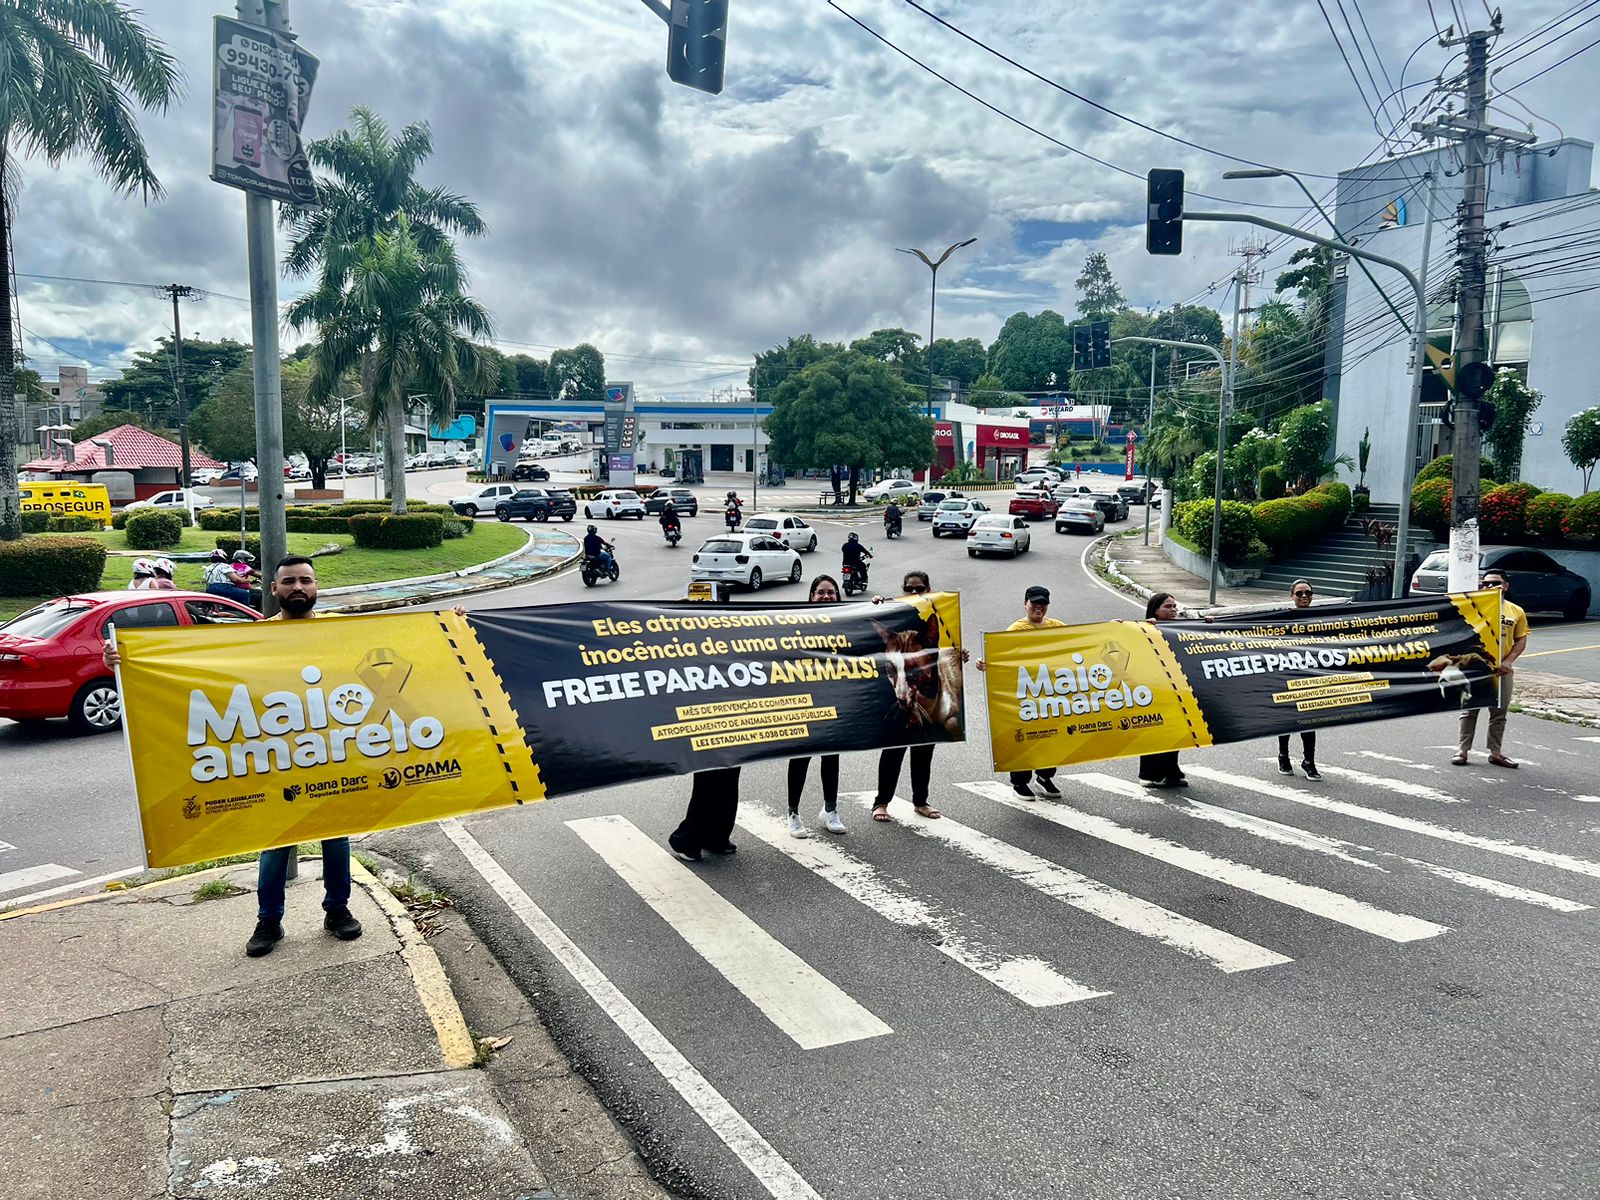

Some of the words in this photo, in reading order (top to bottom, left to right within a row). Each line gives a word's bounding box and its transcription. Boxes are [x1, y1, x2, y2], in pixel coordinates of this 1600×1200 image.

[232, 74, 259, 89] LIGUE
[231, 83, 252, 94] SEU
[257, 89, 286, 108] PEDIDO
[999, 432, 1020, 440] DROGASIL
[23, 501, 105, 513] PROSEGUR
[592, 617, 643, 637] Eles
[645, 613, 774, 633] atravessam
[774, 613, 817, 625] com
[817, 613, 832, 623] a
[1177, 632, 1205, 642] Mais
[1219, 629, 1241, 639] 400
[1291, 622, 1306, 634] de
[1306, 618, 1349, 632] animais
[1350, 615, 1399, 628] silvestres
[1399, 611, 1439, 623] morrem
[579, 636, 698, 667] inocência
[700, 636, 729, 656] de
[730, 637, 778, 654] uma
[780, 629, 852, 655] criança.
[1184, 641, 1229, 655] vítimas
[1229, 640, 1245, 651] de
[1245, 635, 1323, 650] atropelamento
[1323, 635, 1337, 643] no
[1338, 630, 1369, 642] Brasil
[1371, 627, 1400, 639] todos
[1400, 627, 1412, 636] os
[1412, 624, 1439, 634] anos.
[1201, 654, 1266, 680] FREIE
[1263, 650, 1319, 673] PARA
[1317, 648, 1346, 668] OS
[1347, 640, 1431, 665] ANIMAIS!
[541, 671, 646, 709] FREIE
[644, 663, 730, 696] PARA
[727, 661, 768, 688] OS
[770, 656, 880, 685] ANIMAIS!
[1016, 652, 1114, 700] Maio
[1310, 675, 1339, 685] PREVENÇÃO
[1018, 680, 1154, 722] amarelo
[1276, 689, 1319, 701] ATROPELAMENTO
[1326, 686, 1348, 694] ANIMAIS
[186, 665, 375, 747] Maio
[682, 706, 700, 717] MÊS
[701, 705, 713, 715] DE
[713, 700, 758, 713] PREVENÇÃO
[759, 700, 764, 708] E
[764, 697, 798, 708] COMBATE
[798, 696, 808, 704] AO
[1299, 702, 1308, 710] LEI
[1308, 699, 1333, 708] ESTADUAL
[657, 720, 727, 738] ATROPELAMENTO
[728, 719, 740, 728] DE
[740, 715, 772, 727] ANIMAIS
[773, 714, 783, 723] EM
[783, 713, 801, 721] VIAS
[801, 709, 834, 720] PÚBLICAS.
[1078, 722, 1097, 731] Joana
[1097, 719, 1113, 728] Darc
[1131, 712, 1164, 725] CPAMA
[190, 709, 445, 783] amarelo
[695, 738, 711, 748] LEI
[710, 734, 750, 746] ESTADUAL
[760, 730, 779, 739] 5.038
[780, 729, 789, 737] DE
[789, 727, 805, 736] 2019
[403, 758, 462, 780] CPAMA
[305, 780, 339, 794] Joana
[341, 774, 368, 787] Darc
[309, 789, 341, 799] Deputada
[341, 784, 369, 795] Estadual
[205, 799, 226, 807] PODER
[226, 792, 265, 803] LEGISLATIVO
